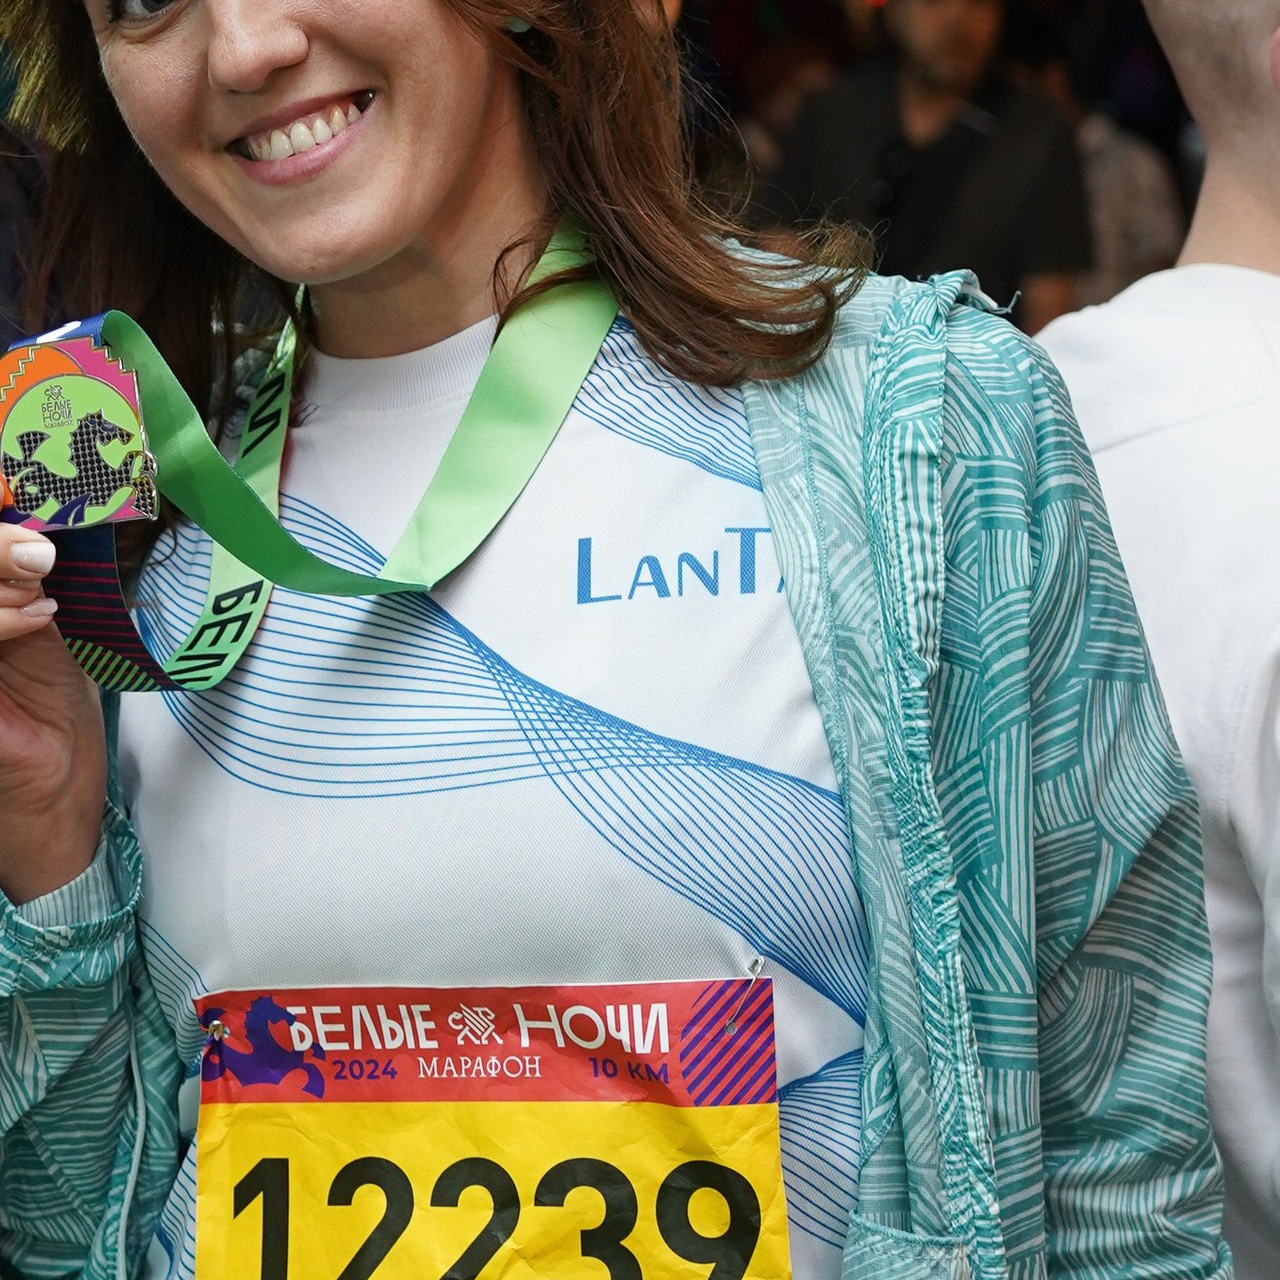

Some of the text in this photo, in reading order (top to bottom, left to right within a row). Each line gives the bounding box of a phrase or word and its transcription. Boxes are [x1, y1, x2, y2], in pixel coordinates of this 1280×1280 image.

[576, 527, 785, 605] LANT
[285, 1002, 670, 1054] БЕЛЫЕ НОЧИ
[332, 1058, 398, 1081] 2024
[417, 1055, 542, 1079] МАРАФОН
[588, 1056, 619, 1079] 10
